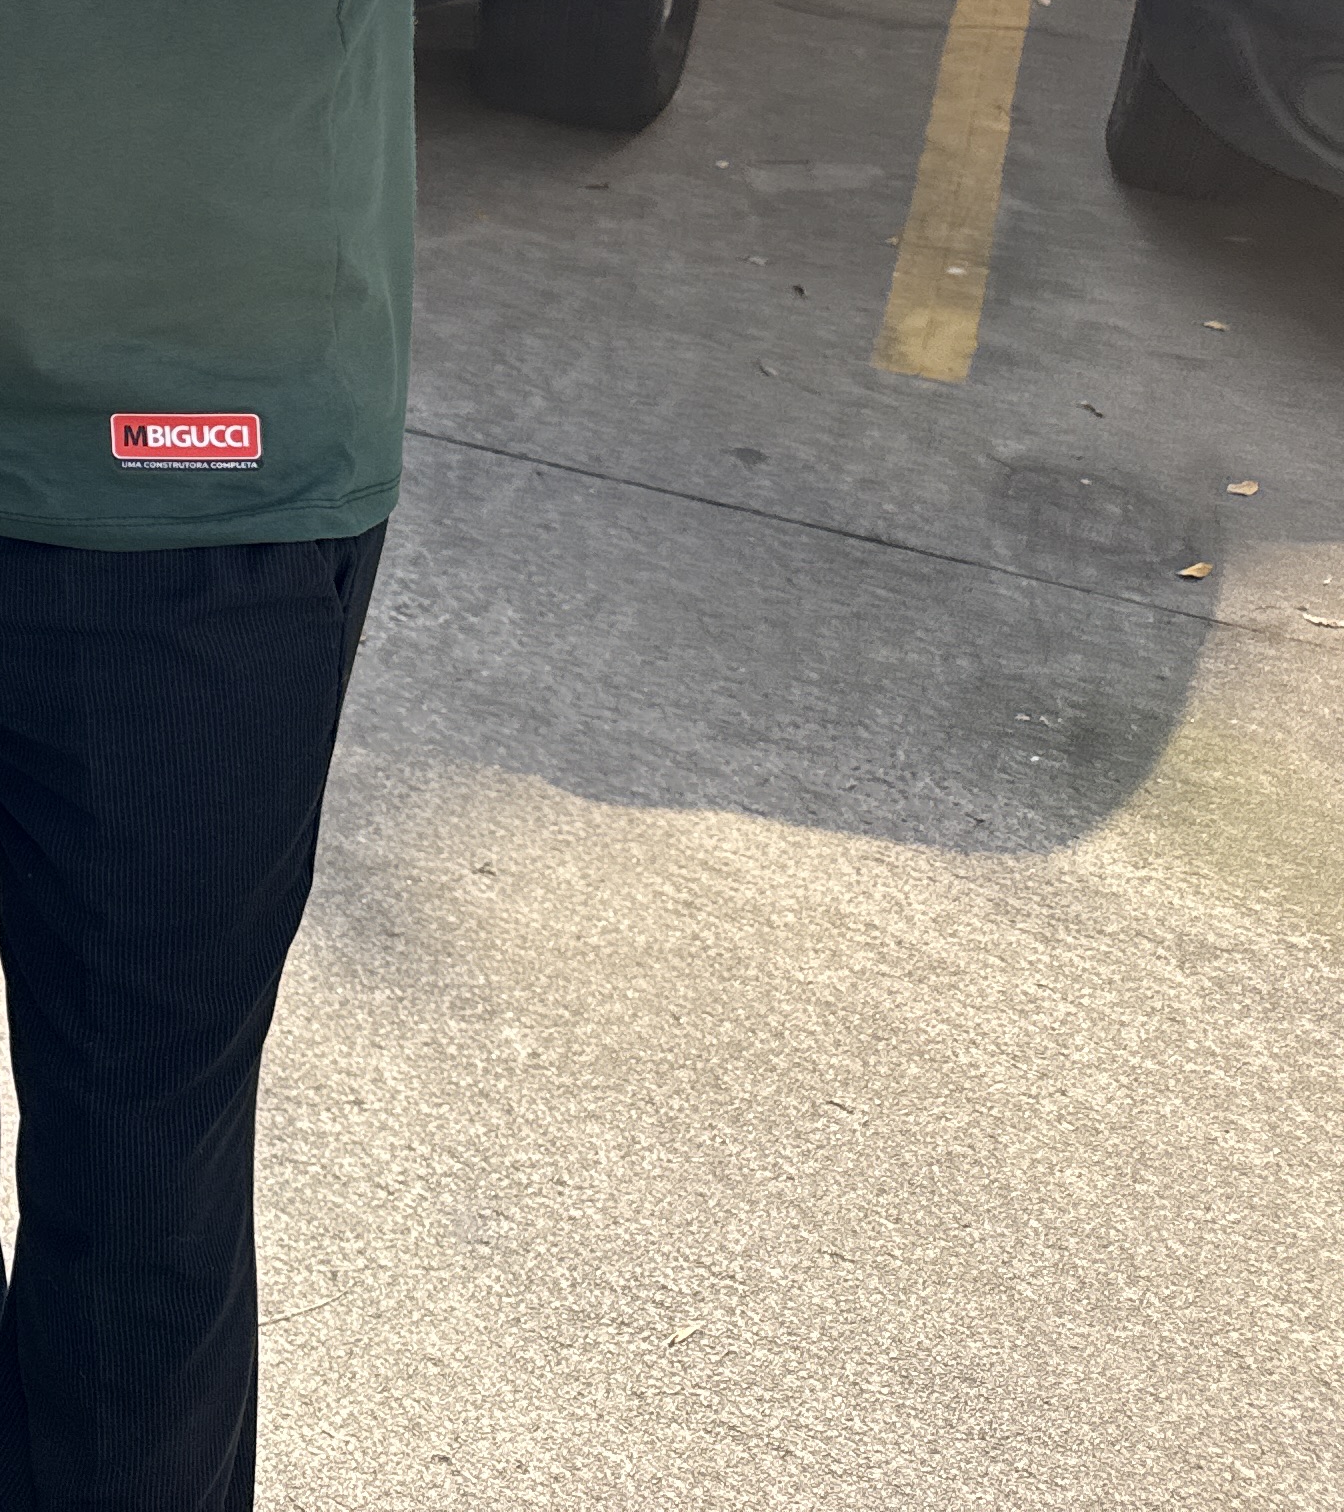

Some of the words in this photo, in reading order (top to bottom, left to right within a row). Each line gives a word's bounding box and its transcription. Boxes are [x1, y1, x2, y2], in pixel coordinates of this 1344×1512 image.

[123, 424, 250, 448] MBIGUCCI
[122, 461, 142, 469] UMA
[143, 461, 209, 470] CONSTRUTORA
[210, 462, 258, 470] COMPLETA
